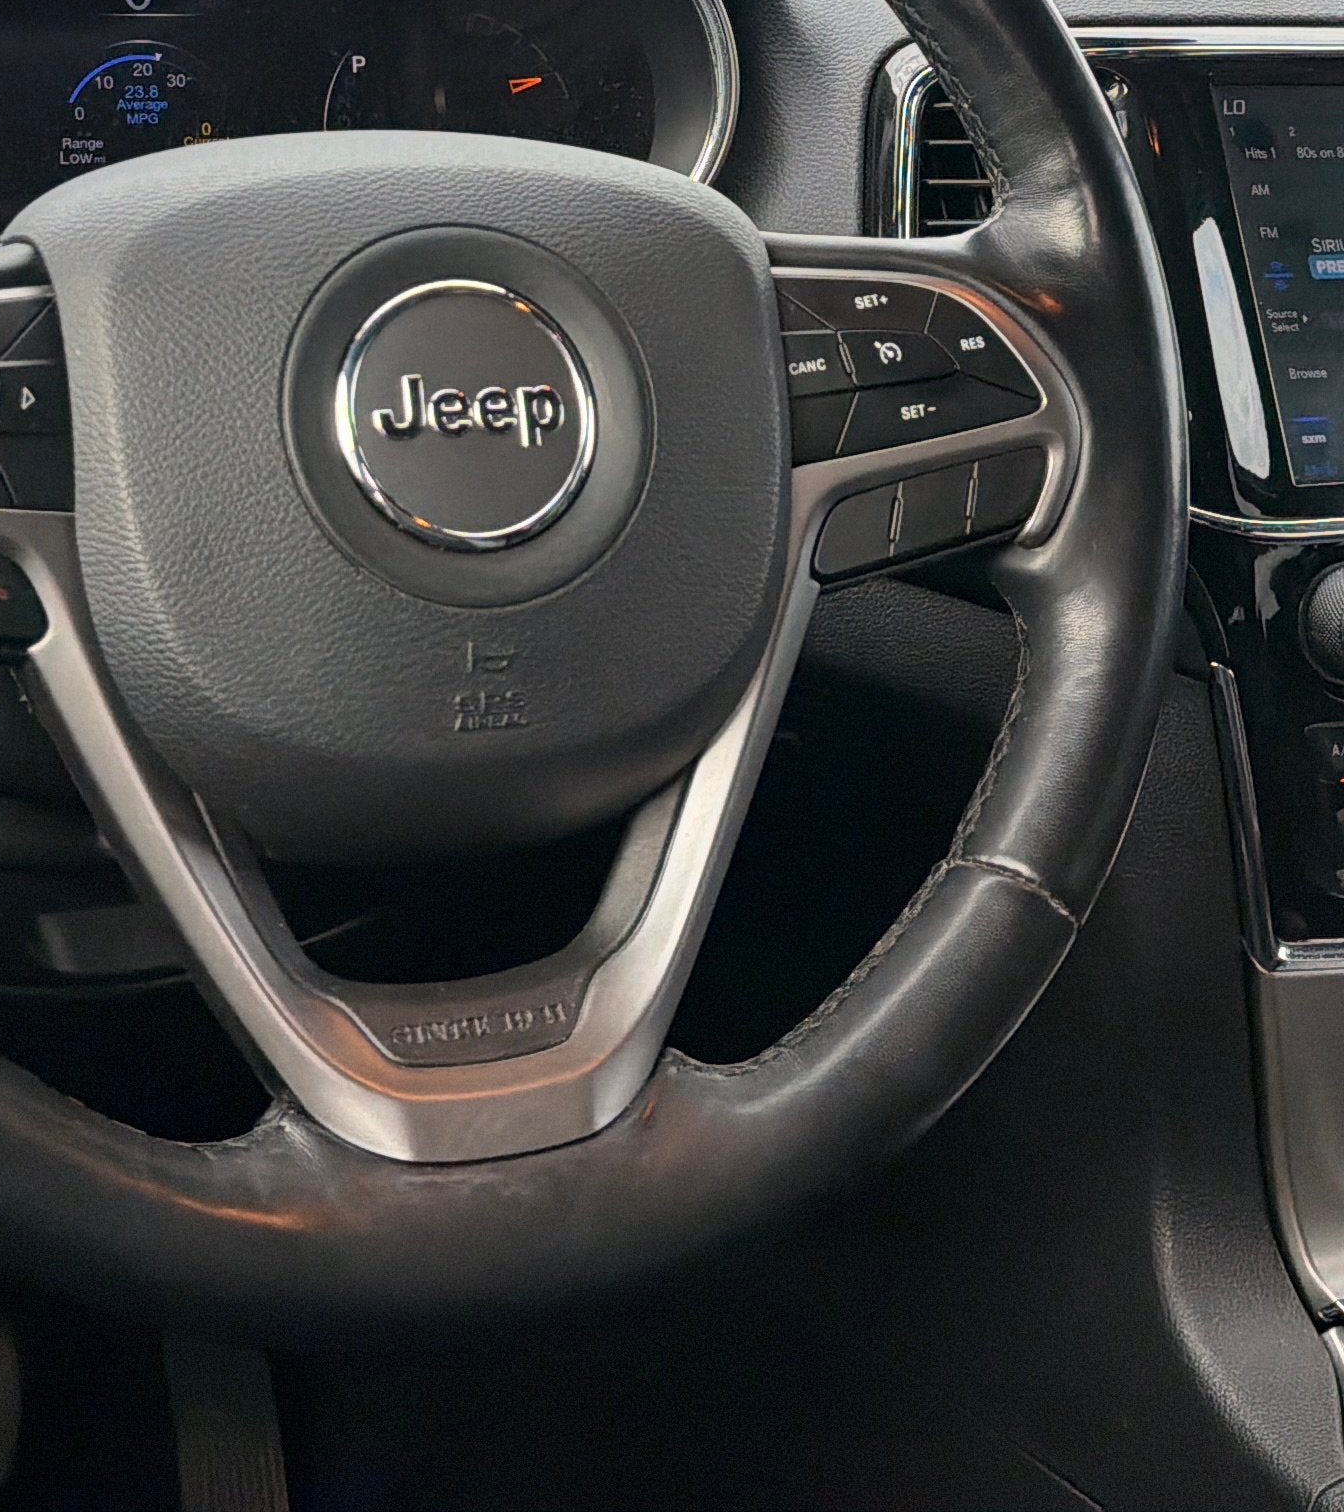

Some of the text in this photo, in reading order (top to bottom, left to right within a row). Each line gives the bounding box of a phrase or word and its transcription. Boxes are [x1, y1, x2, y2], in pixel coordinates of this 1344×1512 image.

[133, 63, 153, 77] 20
[352, 56, 367, 73] P
[95, 76, 114, 90] 10
[166, 74, 186, 88] 30
[125, 85, 158, 99] 23.8
[116, 99, 168, 113] Average
[1223, 99, 1246, 116] LO
[74, 107, 85, 121] 0
[127, 113, 159, 125] MPG
[201, 122, 212, 136] 0
[62, 138, 104, 151] Range
[1245, 148, 1268, 159] Hits
[1296, 147, 1344, 159] 80s on 8
[1251, 184, 1271, 196] AM
[1260, 226, 1279, 239] FM
[1266, 308, 1298, 319] Source
[1272, 322, 1300, 333] Select
[960, 336, 986, 352] RES
[788, 358, 827, 376] CANC
[1288, 367, 1328, 380] Browse
[371, 373, 566, 449] Jeep
[1301, 434, 1327, 444] sxm
